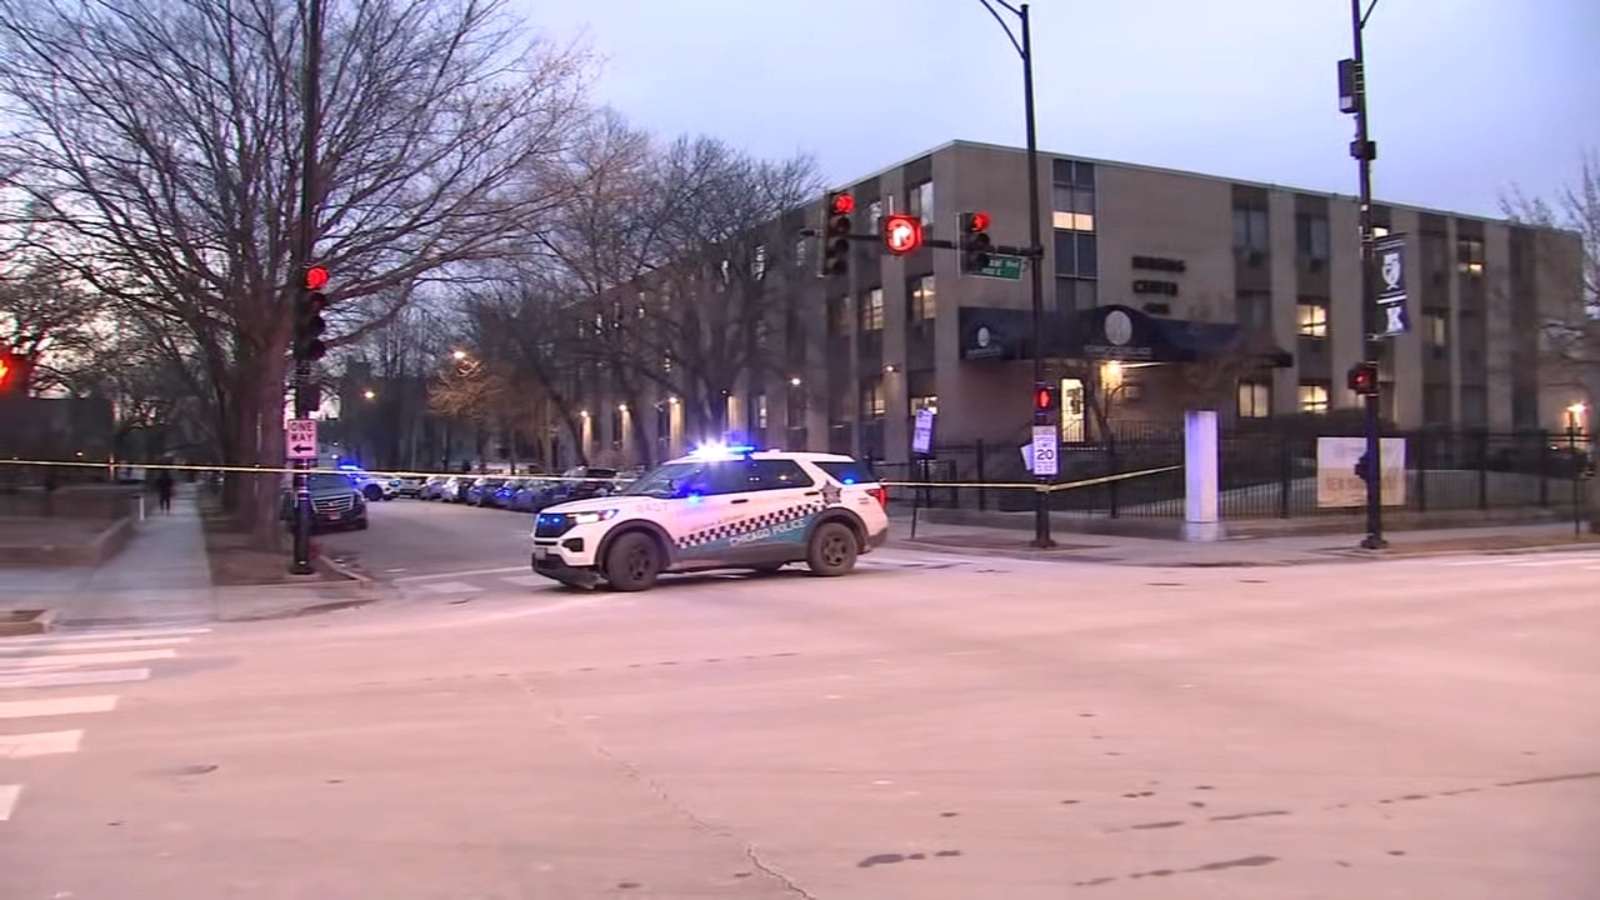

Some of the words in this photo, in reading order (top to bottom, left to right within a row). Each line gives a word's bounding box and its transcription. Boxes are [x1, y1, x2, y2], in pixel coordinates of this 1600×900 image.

[291, 422, 313, 431] ONE
[291, 433, 313, 441] WAY
[1036, 449, 1055, 460] 20
[729, 528, 771, 547] CHICAGO
[773, 518, 806, 536] POLICE
